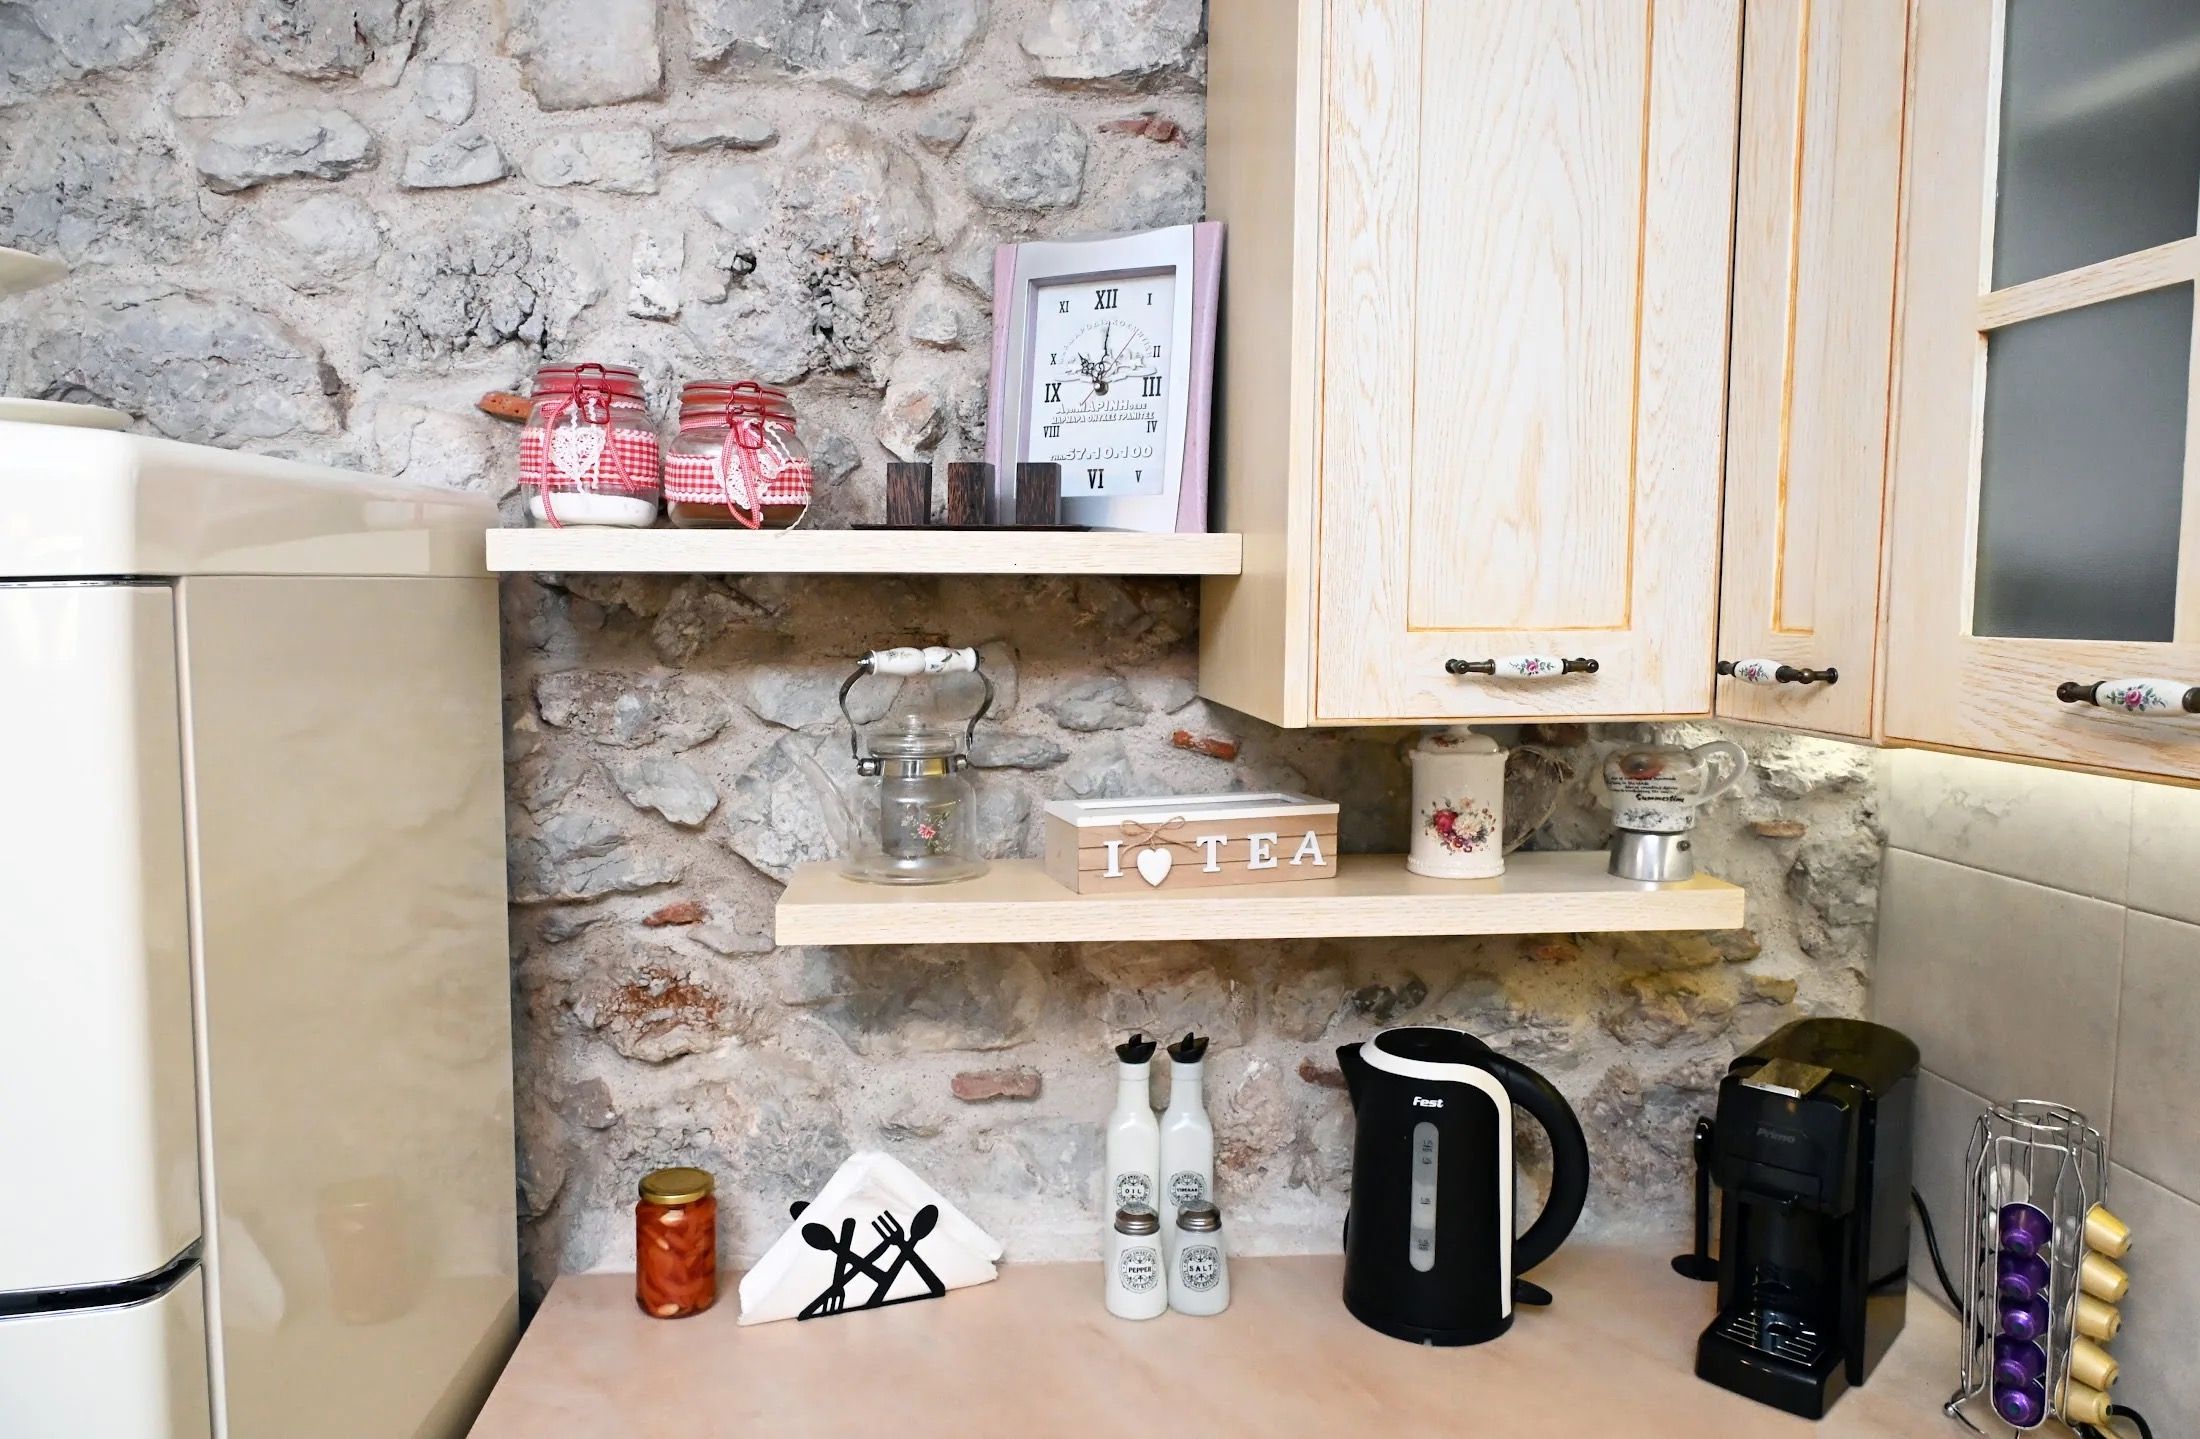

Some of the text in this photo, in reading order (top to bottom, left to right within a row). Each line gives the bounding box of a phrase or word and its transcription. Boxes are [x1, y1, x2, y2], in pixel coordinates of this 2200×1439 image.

[1094, 289, 1118, 310] XII
[1059, 300, 1069, 313] XI
[1153, 346, 1160, 358] II
[1050, 353, 1057, 365] X
[1044, 383, 1062, 403] IX
[1142, 376, 1162, 397] III
[1043, 425, 1060, 438] VIII
[1146, 420, 1158, 433] IV
[1087, 469, 1104, 489] VI
[1135, 470, 1142, 483] V
[1103, 830, 1327, 878] I TEA
[1413, 1096, 1444, 1108] Fest
[1190, 1264, 1212, 1272] SALT
